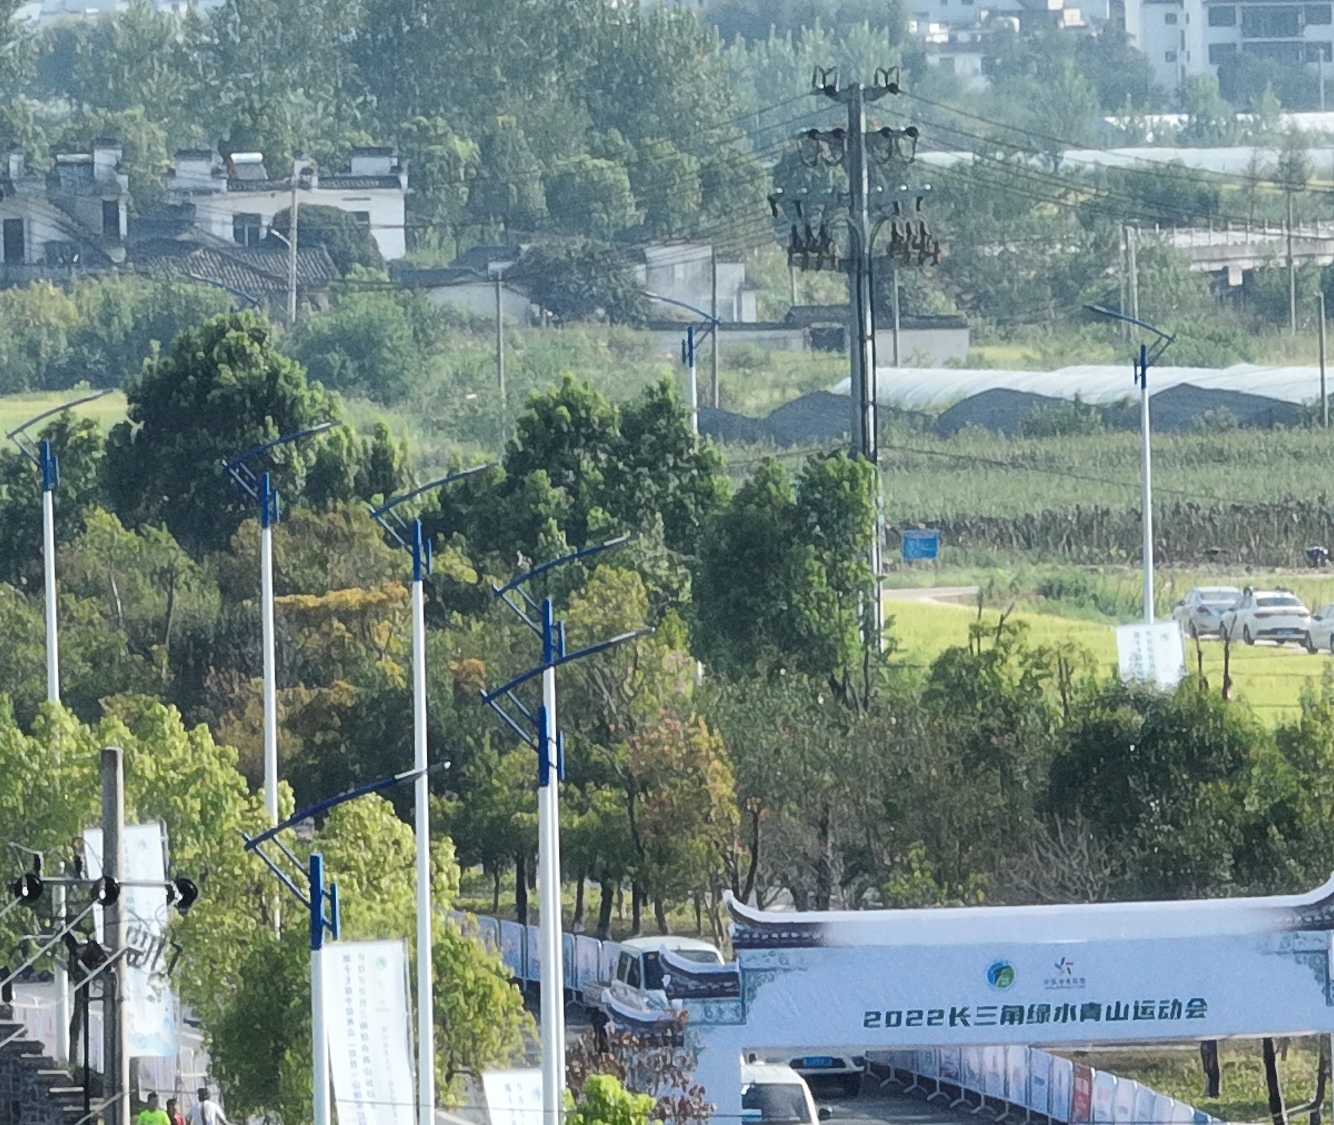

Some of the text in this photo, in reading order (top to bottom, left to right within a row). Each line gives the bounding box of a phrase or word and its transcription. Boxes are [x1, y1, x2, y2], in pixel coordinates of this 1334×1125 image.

[863, 997, 1208, 1029] 2022长三角绿水青山运动会
